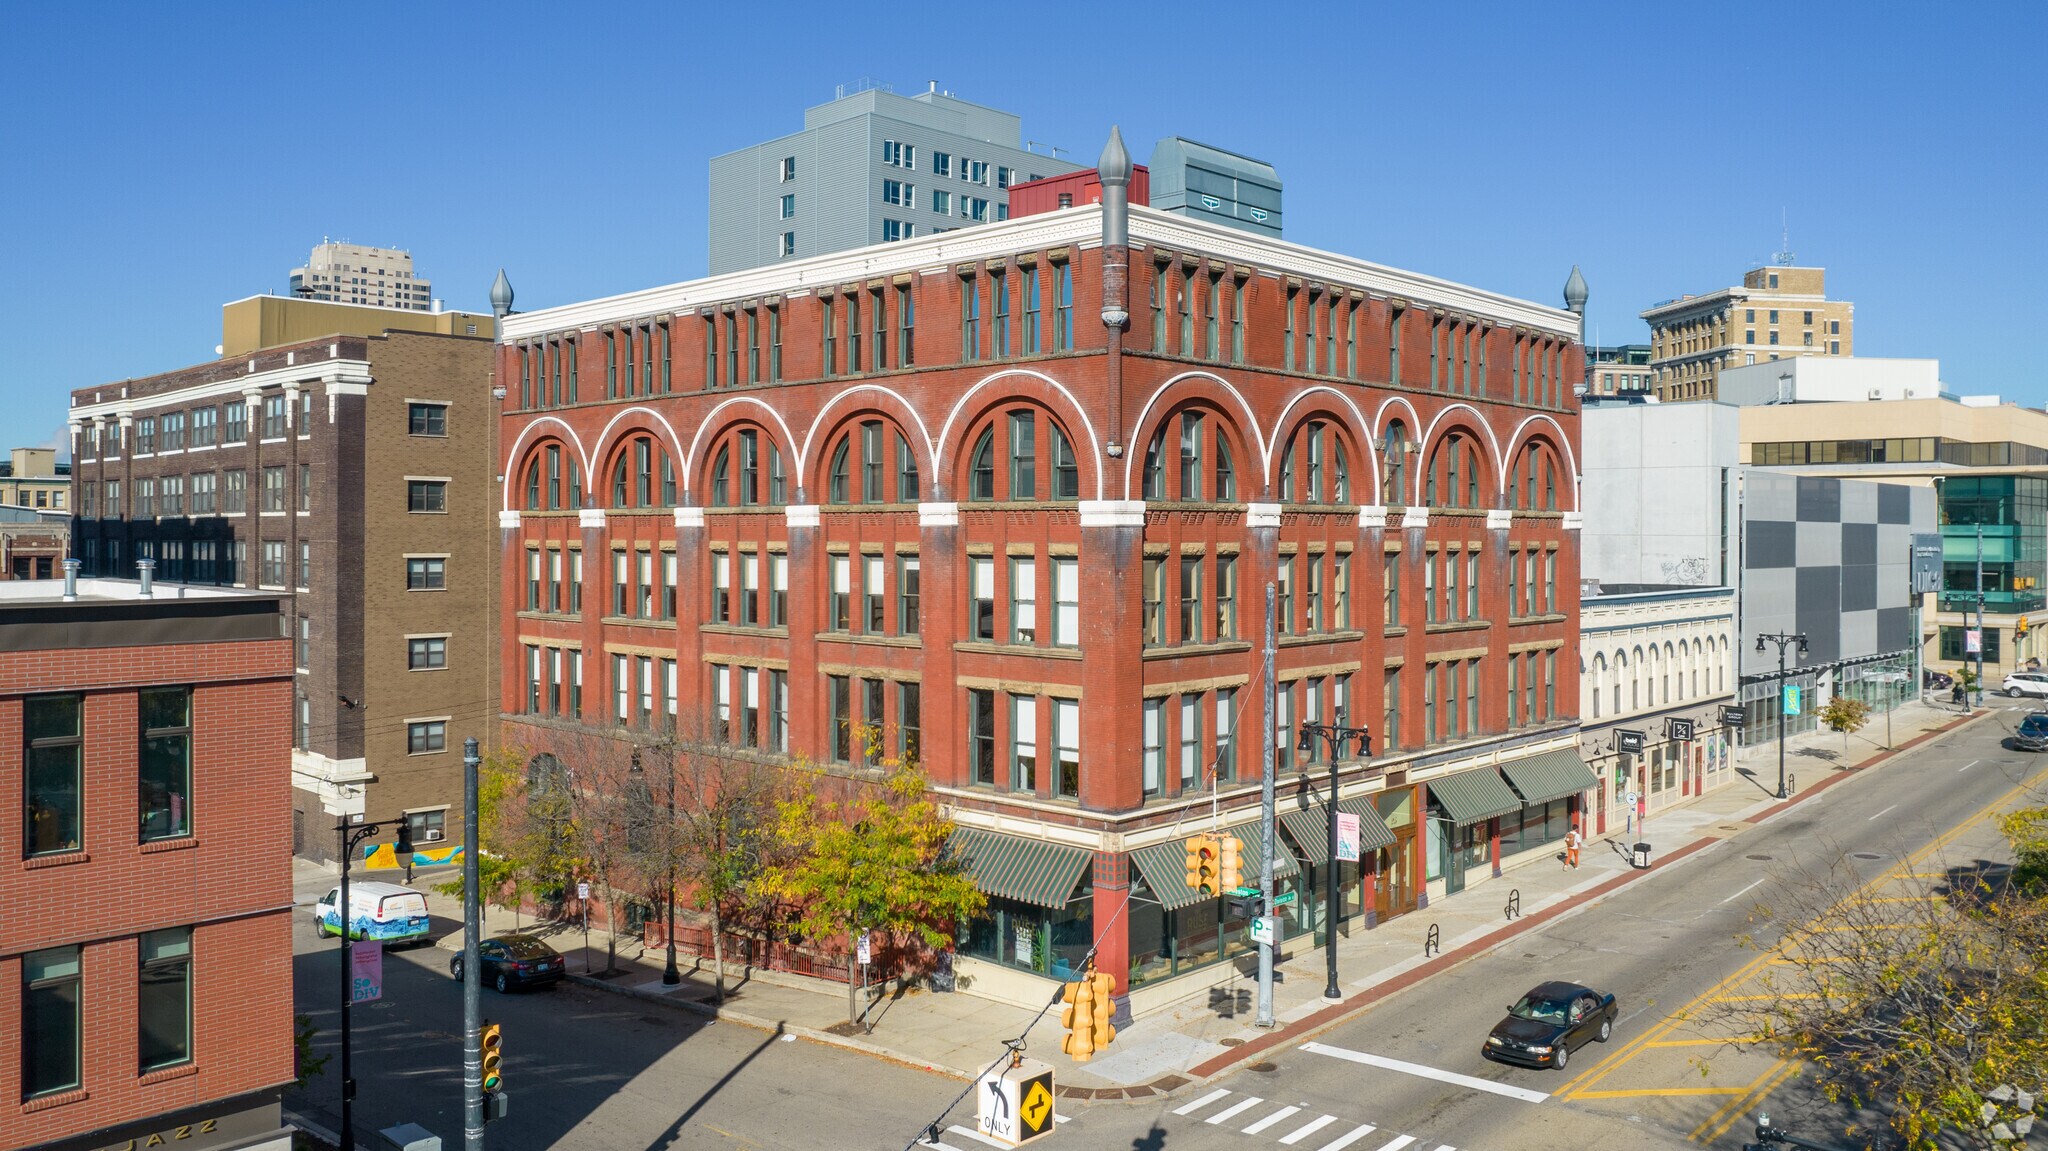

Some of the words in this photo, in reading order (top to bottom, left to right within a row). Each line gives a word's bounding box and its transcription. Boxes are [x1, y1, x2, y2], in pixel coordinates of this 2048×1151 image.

[1012, 918, 1038, 939] RUSE
[353, 986, 379, 1001] DIV
[123, 1119, 218, 1151] JAZZ
[985, 1117, 1010, 1135] ONLY
